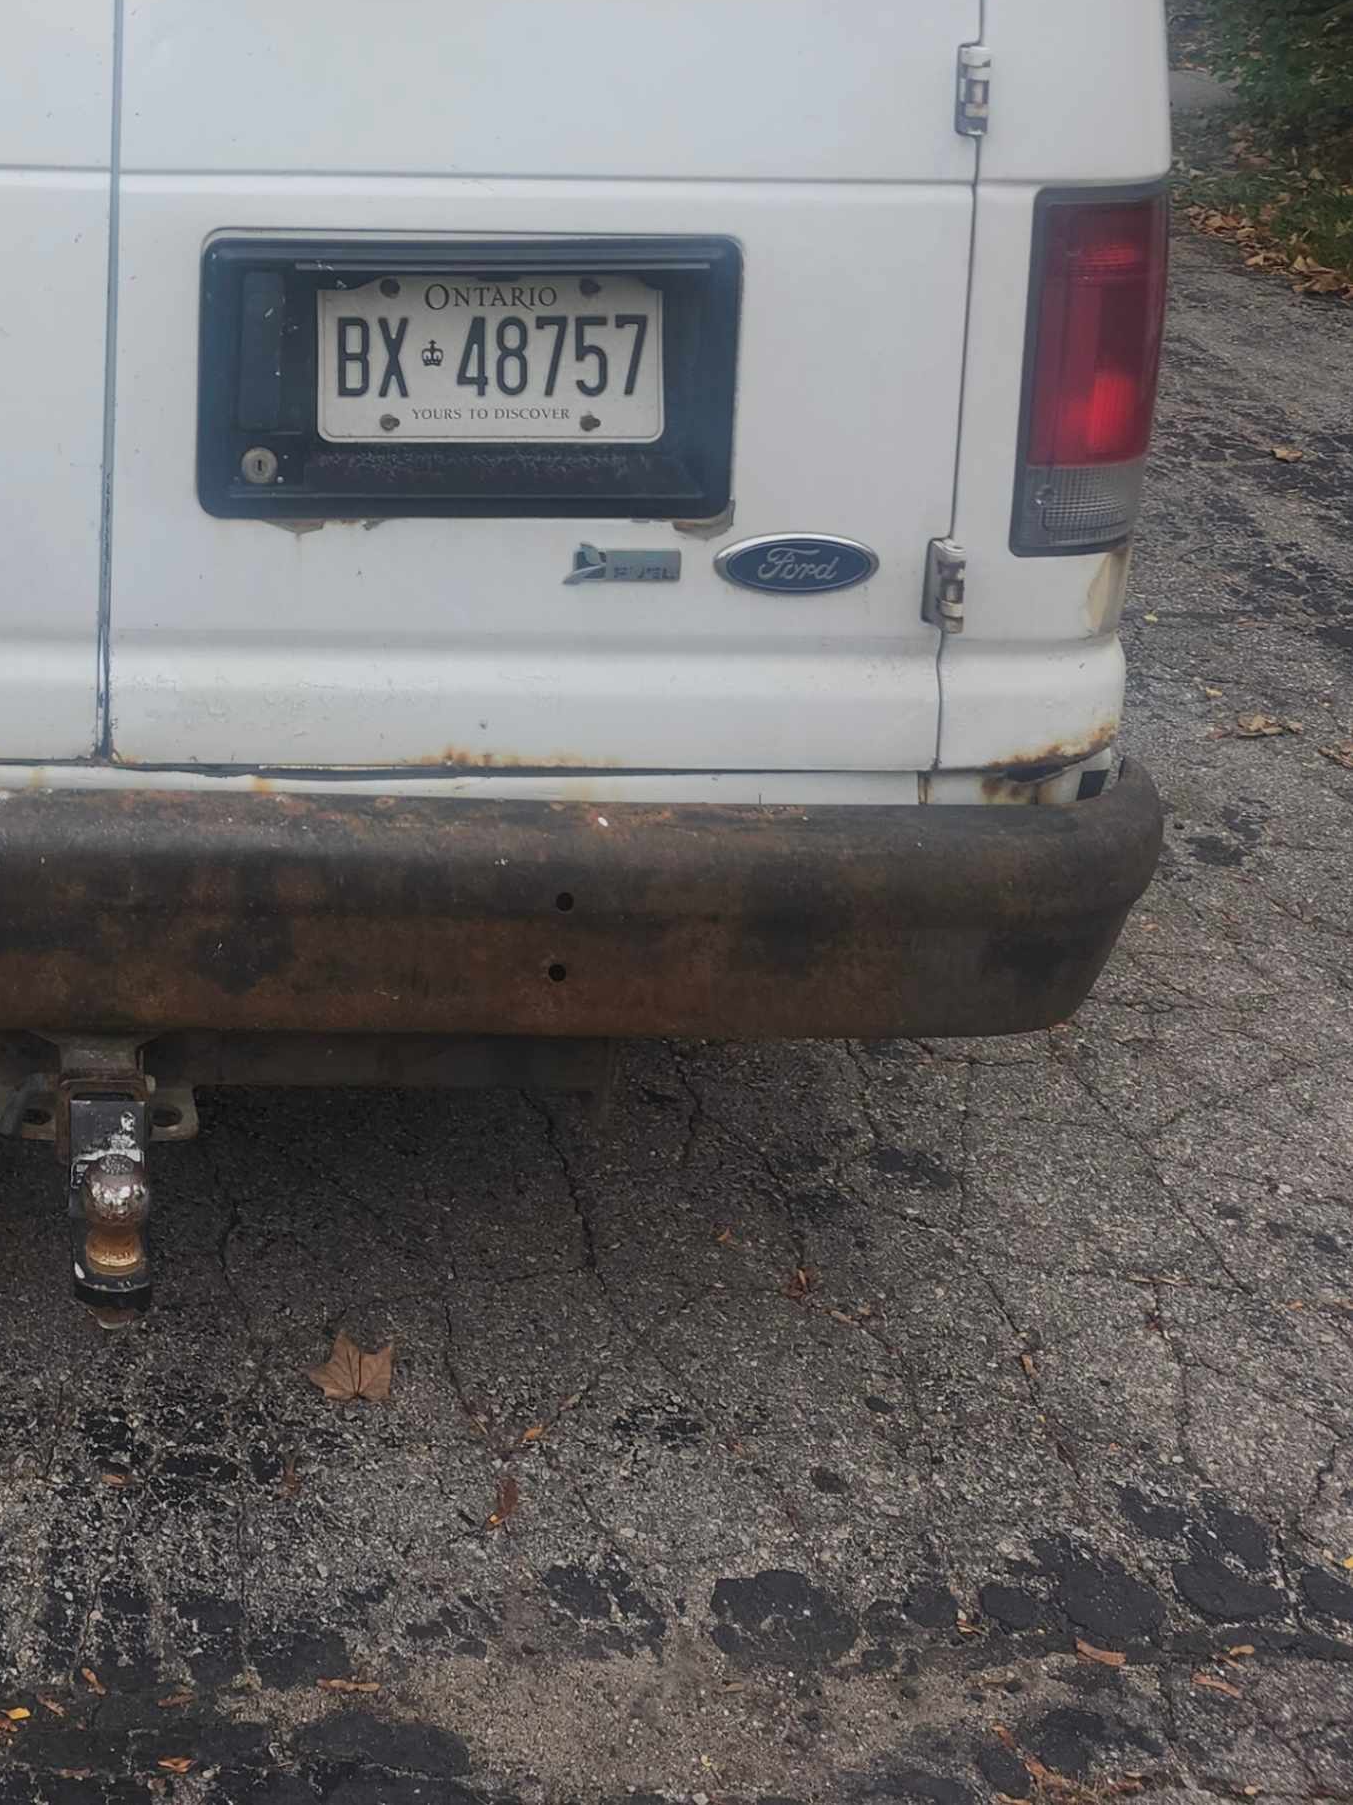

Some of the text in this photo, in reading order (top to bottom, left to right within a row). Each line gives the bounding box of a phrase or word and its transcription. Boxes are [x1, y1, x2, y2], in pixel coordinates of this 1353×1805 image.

[424, 282, 559, 311] ONTARIO
[337, 314, 648, 397] BX 48757
[412, 408, 571, 420] YOURS TO DISCOVER
[757, 546, 838, 581] Ford
